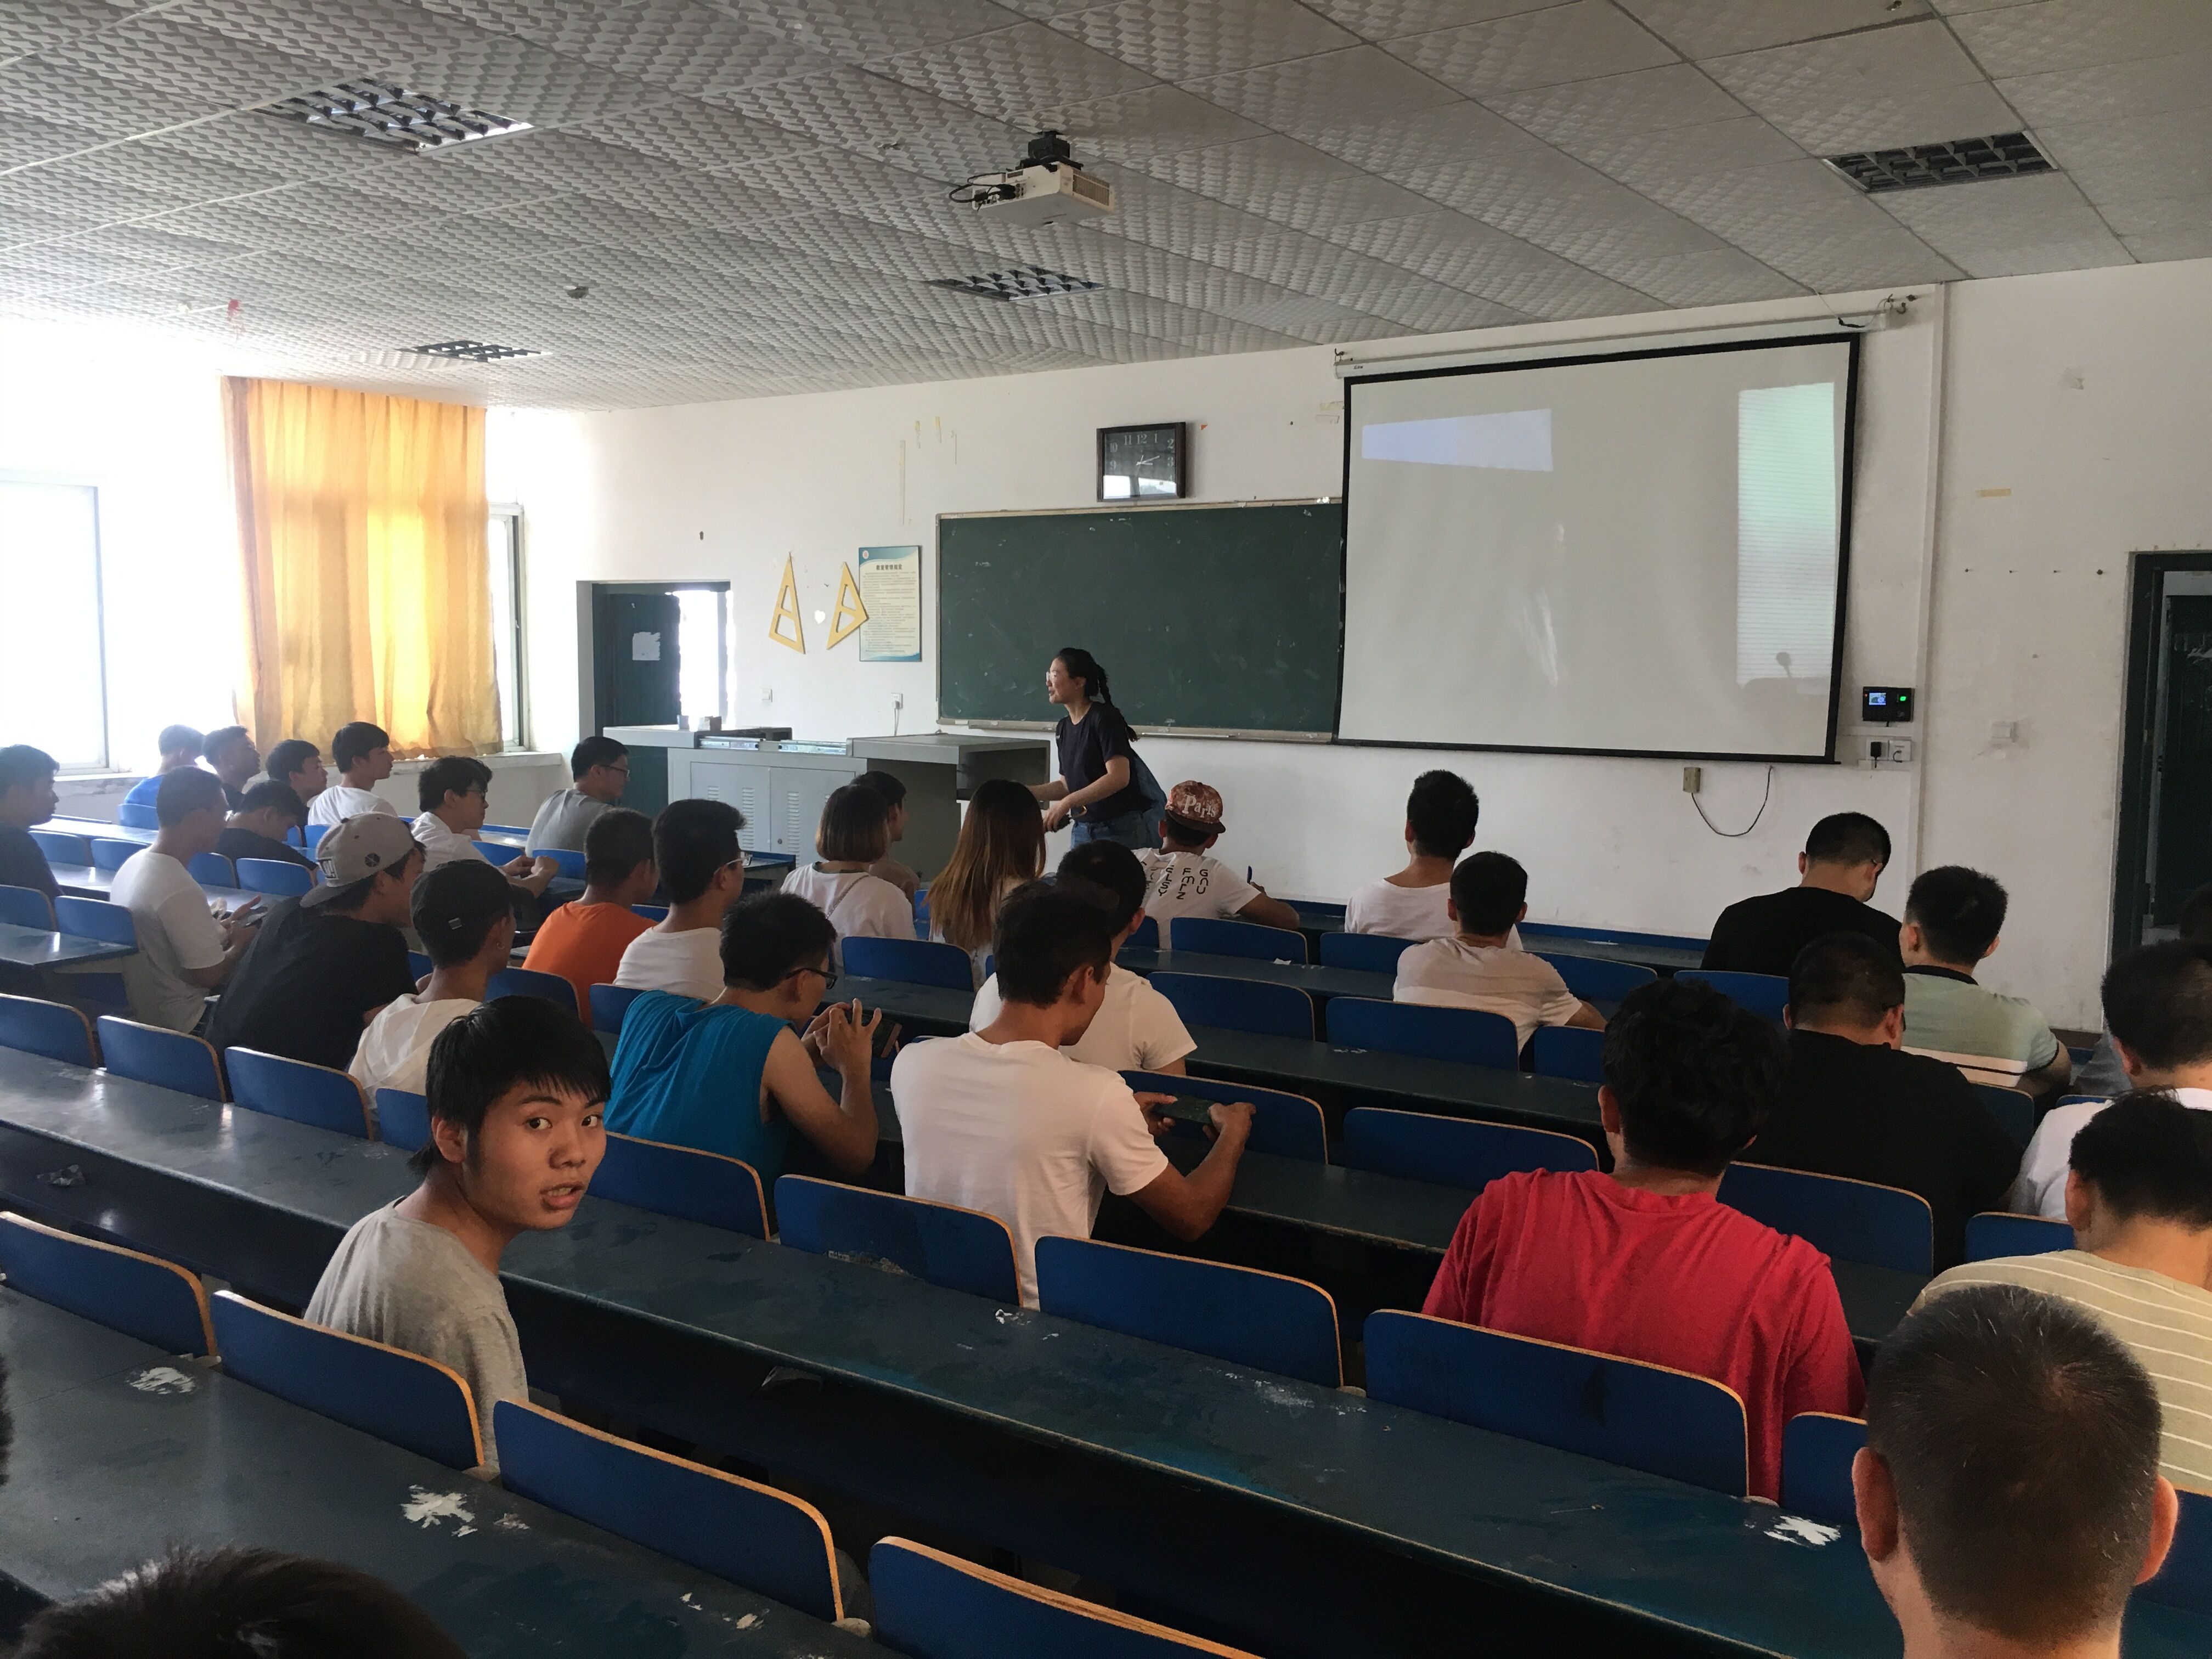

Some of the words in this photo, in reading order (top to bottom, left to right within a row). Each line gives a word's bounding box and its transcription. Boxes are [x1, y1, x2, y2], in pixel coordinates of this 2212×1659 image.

[1124, 435, 1132, 445] 11
[1137, 433, 1148, 444] 12
[1154, 433, 1158, 443] 1
[1167, 438, 1175, 449] 2
[1110, 442, 1118, 453] 10
[1110, 460, 1116, 470] 9
[1167, 456, 1174, 467] 3
[1182, 794, 1216, 818] Paris
